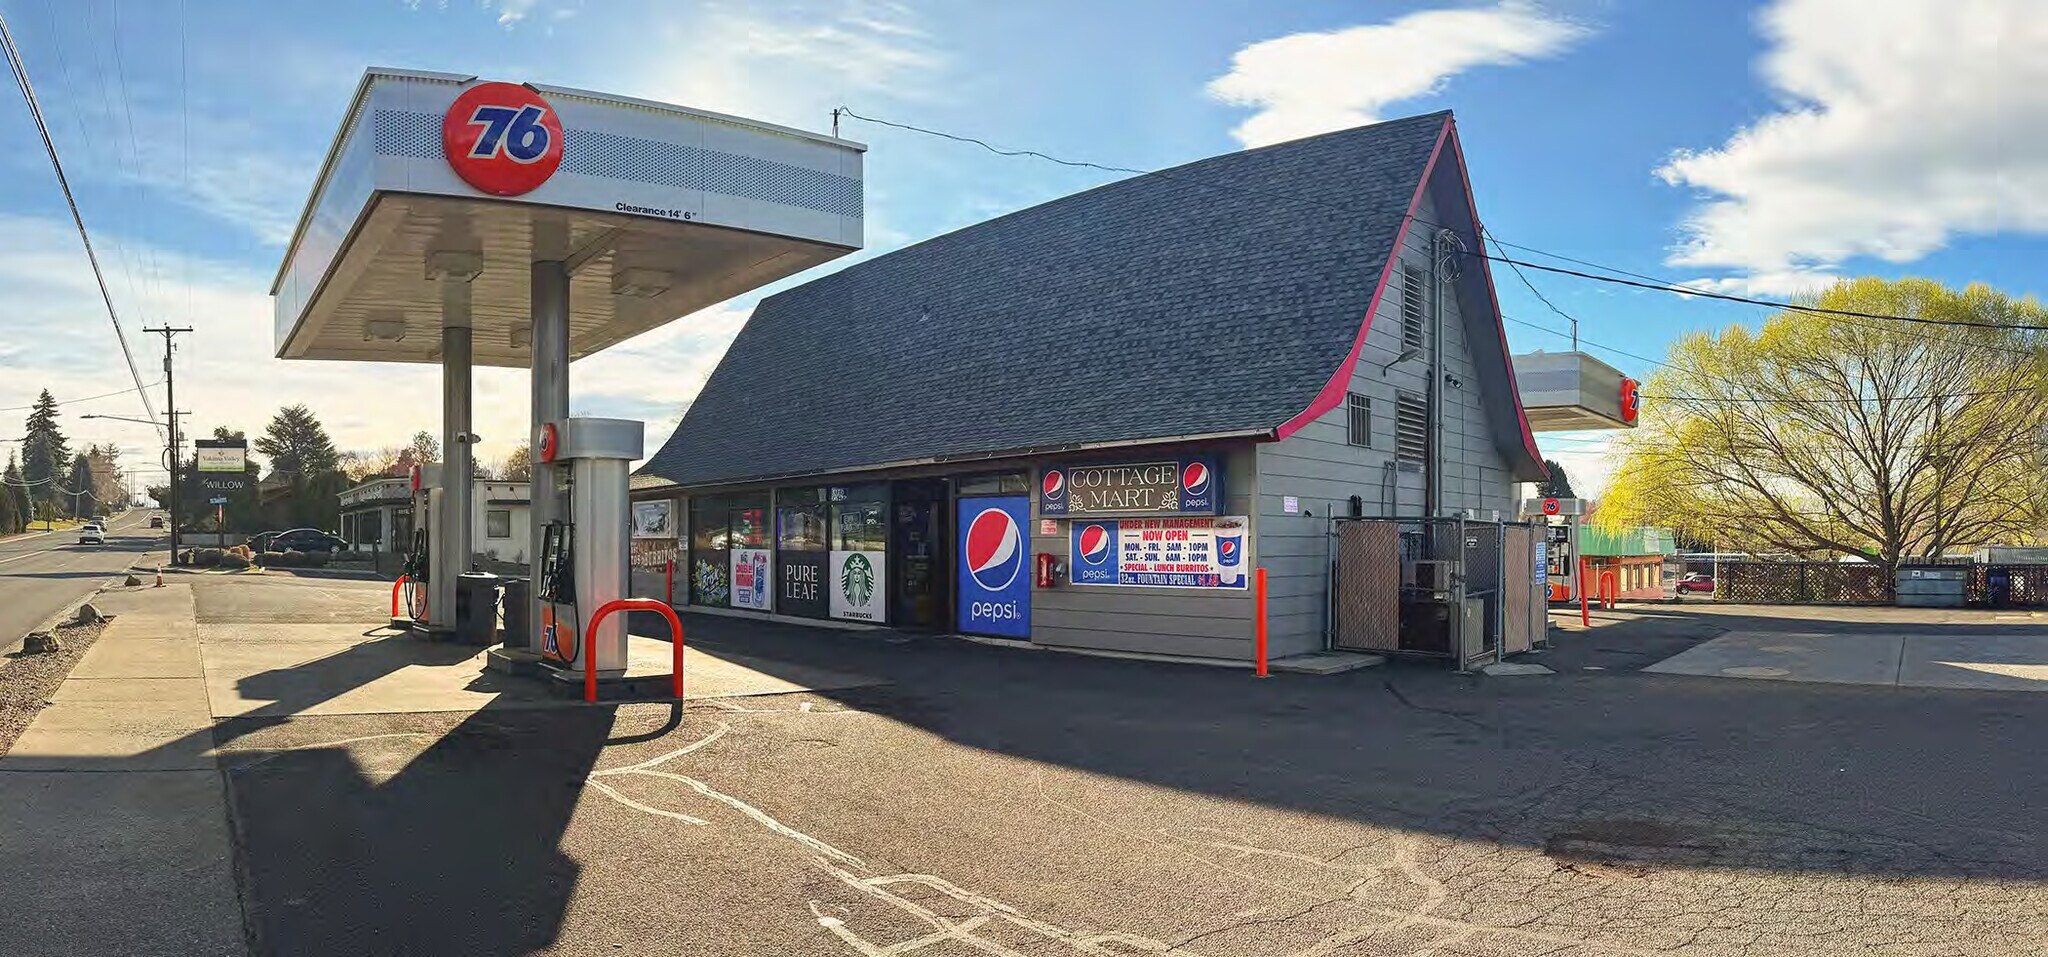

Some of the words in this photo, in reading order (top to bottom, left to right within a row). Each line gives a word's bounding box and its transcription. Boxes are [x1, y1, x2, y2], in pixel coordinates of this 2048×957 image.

[467, 103, 551, 164] 76
[616, 202, 666, 216] Clearance
[668, 209, 681, 218] 14'
[1071, 466, 1175, 488] COTTAGE
[206, 481, 244, 489] WILLOW
[1090, 489, 1155, 508] MART
[1185, 498, 1208, 508] pepsi
[1045, 502, 1063, 511] pepsi
[1545, 502, 1556, 511] 76
[1120, 520, 1142, 529] UNDER
[1145, 520, 1160, 529] NEW
[1163, 519, 1214, 529] MANAGEMENT
[1142, 530, 1164, 541] NOW
[1165, 530, 1188, 541] OPEN
[1125, 543, 1142, 551] MON.
[1149, 543, 1161, 551] FRI.
[1166, 543, 1181, 551] 5AM
[1189, 543, 1208, 551] 10PM
[1126, 553, 1138, 561] SAT.
[1145, 553, 1160, 561] SUN.
[1166, 553, 1180, 561] 6AM
[1188, 553, 1207, 561] 10PM
[1124, 563, 1148, 571] SPECIAL
[1154, 563, 1176, 572] LUNCH
[1176, 563, 1209, 572] BURRITOS
[787, 565, 818, 582] PURE
[1082, 569, 1108, 580] pepsi
[1138, 574, 1168, 585] FOUNTAIN
[1169, 574, 1196, 585] SPECIAL
[786, 582, 818, 600] LEAF
[843, 611, 872, 619] STARBUCKS
[972, 600, 1017, 622] pepsi
